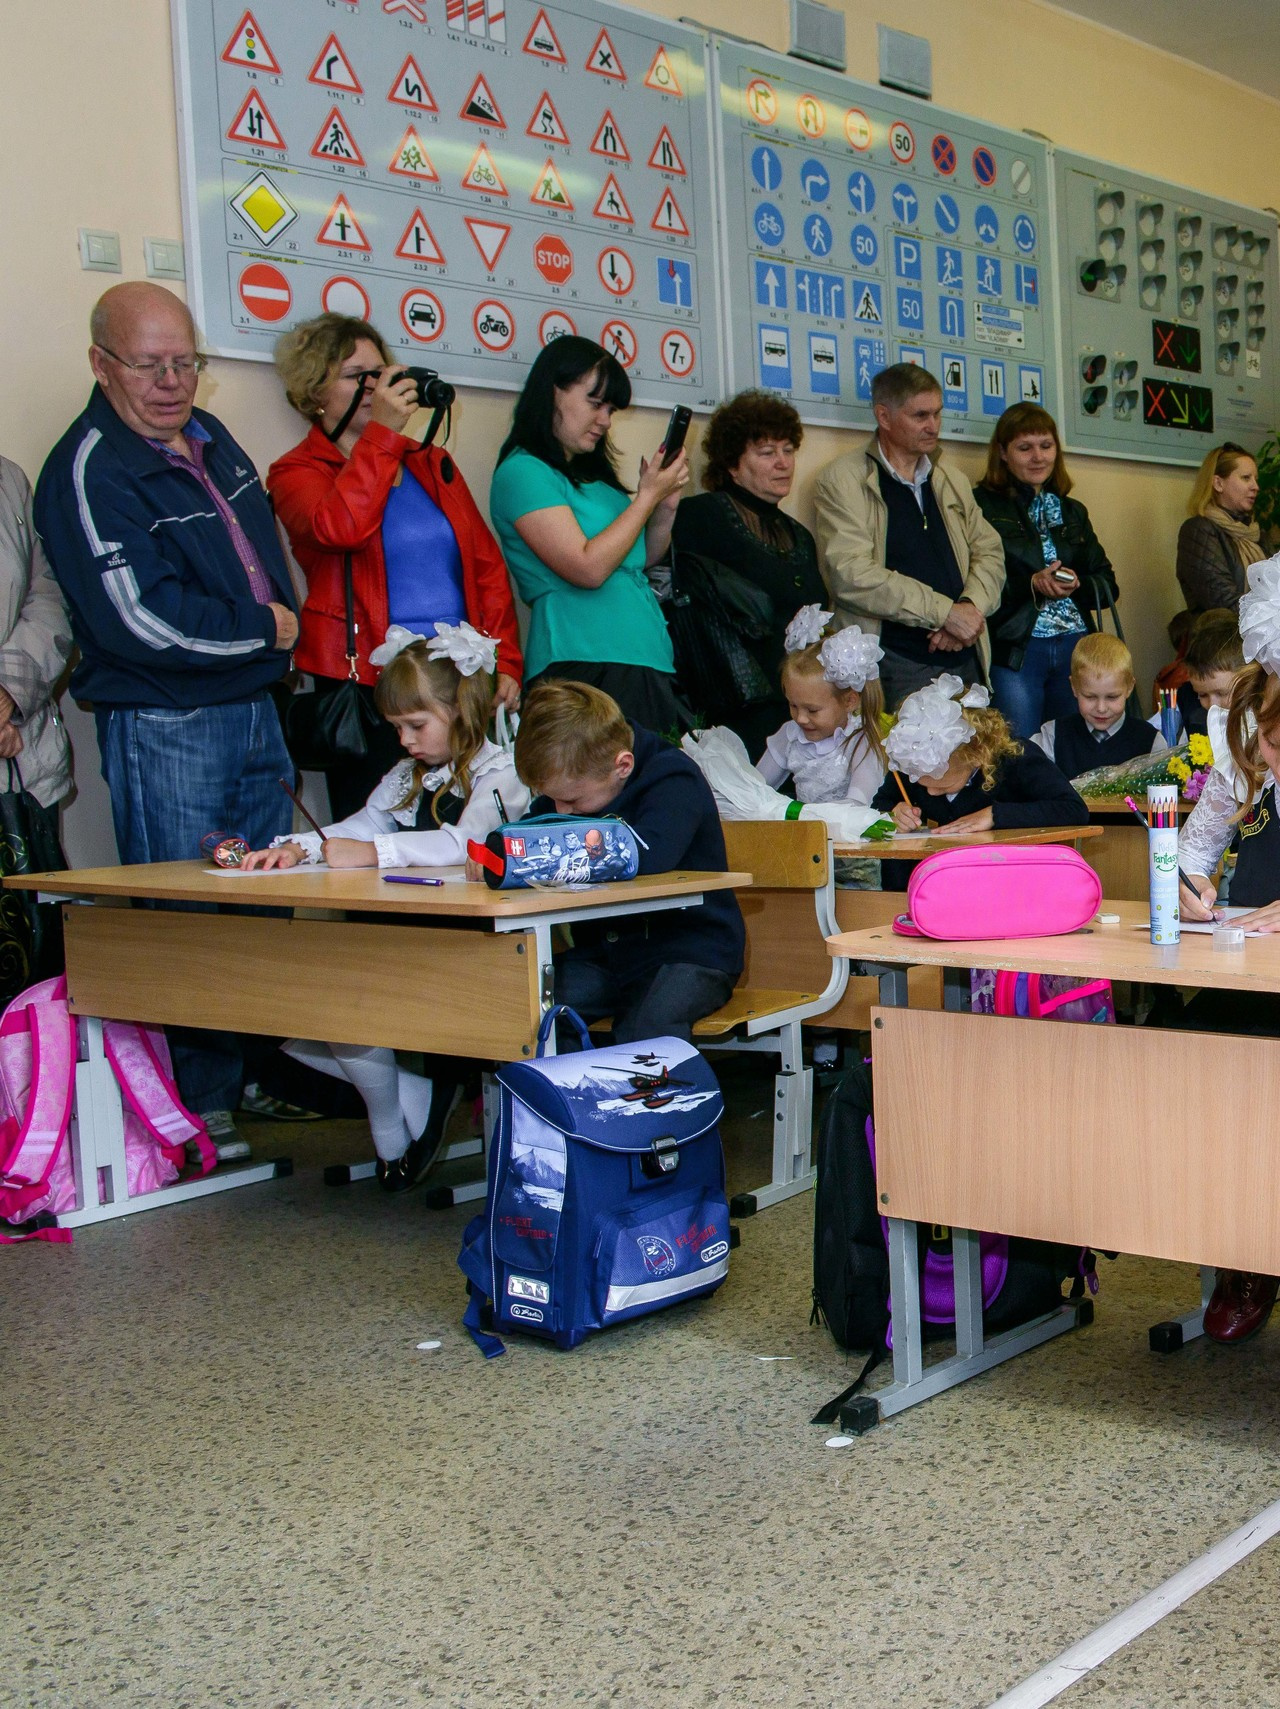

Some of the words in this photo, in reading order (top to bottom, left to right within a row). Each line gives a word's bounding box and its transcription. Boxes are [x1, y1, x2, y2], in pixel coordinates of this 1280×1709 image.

[399, 20, 413, 29] 1.3.2
[327, 91, 345, 100] 1.11.1
[477, 96, 494, 114] 12%
[404, 110, 422, 119] 1.12.2
[895, 134, 910, 152] 50
[252, 148, 264, 156] 1.21
[332, 165, 346, 174] 1.22
[856, 236, 874, 256] 50
[338, 250, 352, 258] 2.3.1
[900, 242, 916, 274] P
[537, 250, 570, 270] STOP
[414, 264, 428, 272] 2.3.2
[902, 298, 920, 320] 50
[1154, 852, 1178, 864] Fantasy
